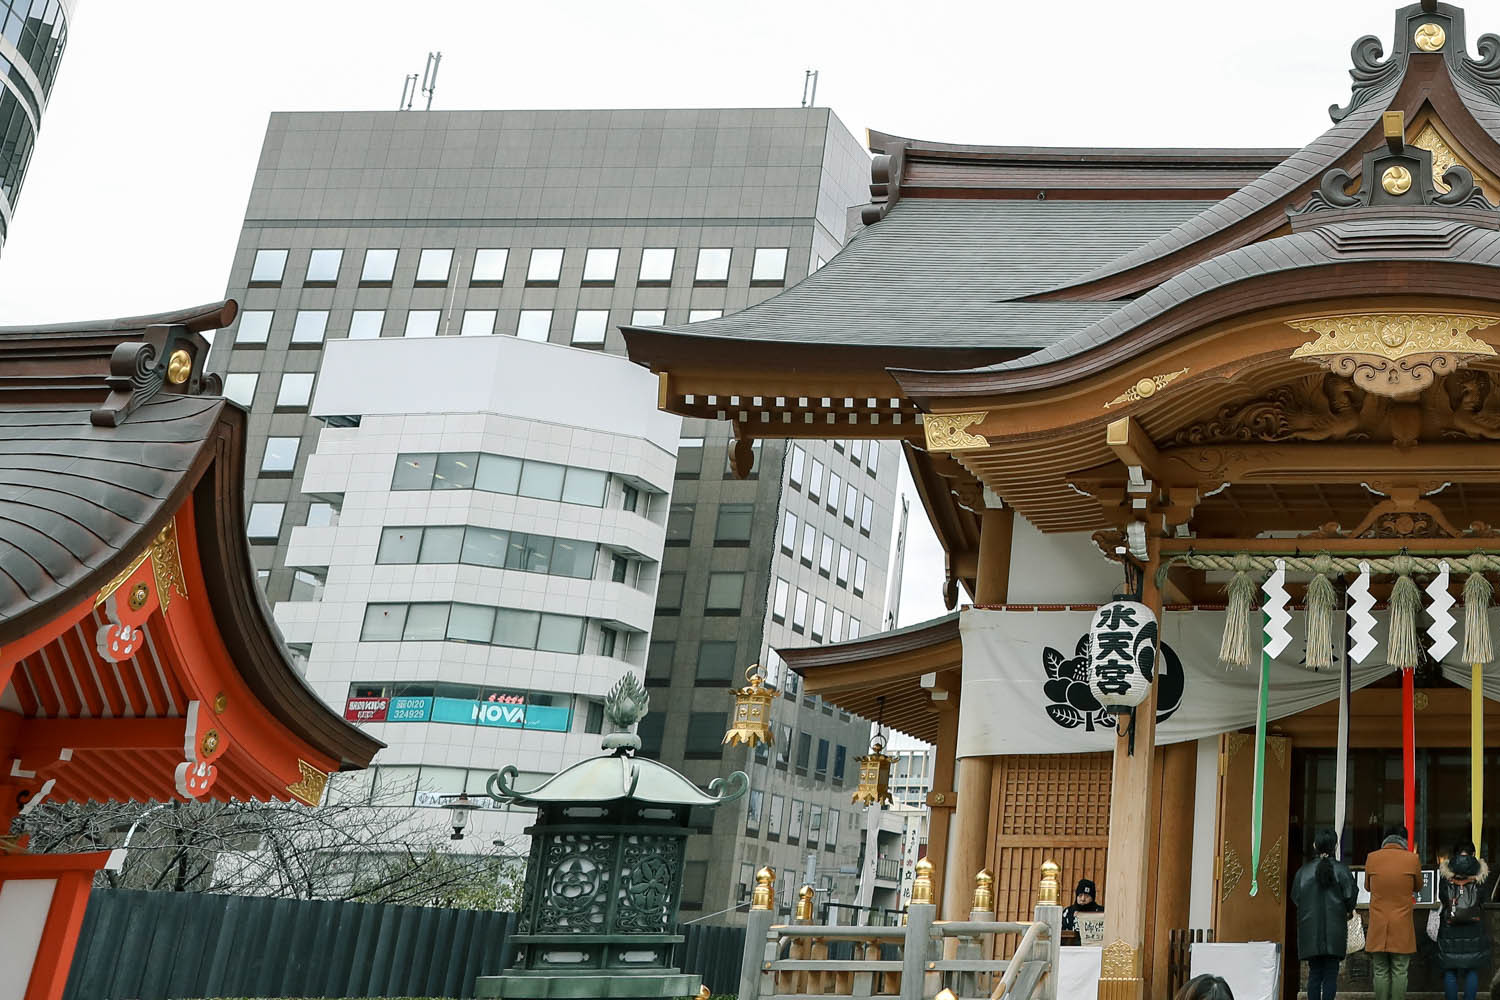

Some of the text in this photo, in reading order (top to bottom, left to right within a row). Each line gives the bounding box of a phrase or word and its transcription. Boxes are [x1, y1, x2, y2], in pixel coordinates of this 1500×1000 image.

[1095, 603, 1139, 695] 水天宮
[407, 699, 425, 709] 0120
[393, 709, 424, 719] 324929
[472, 703, 527, 724] NOVA
